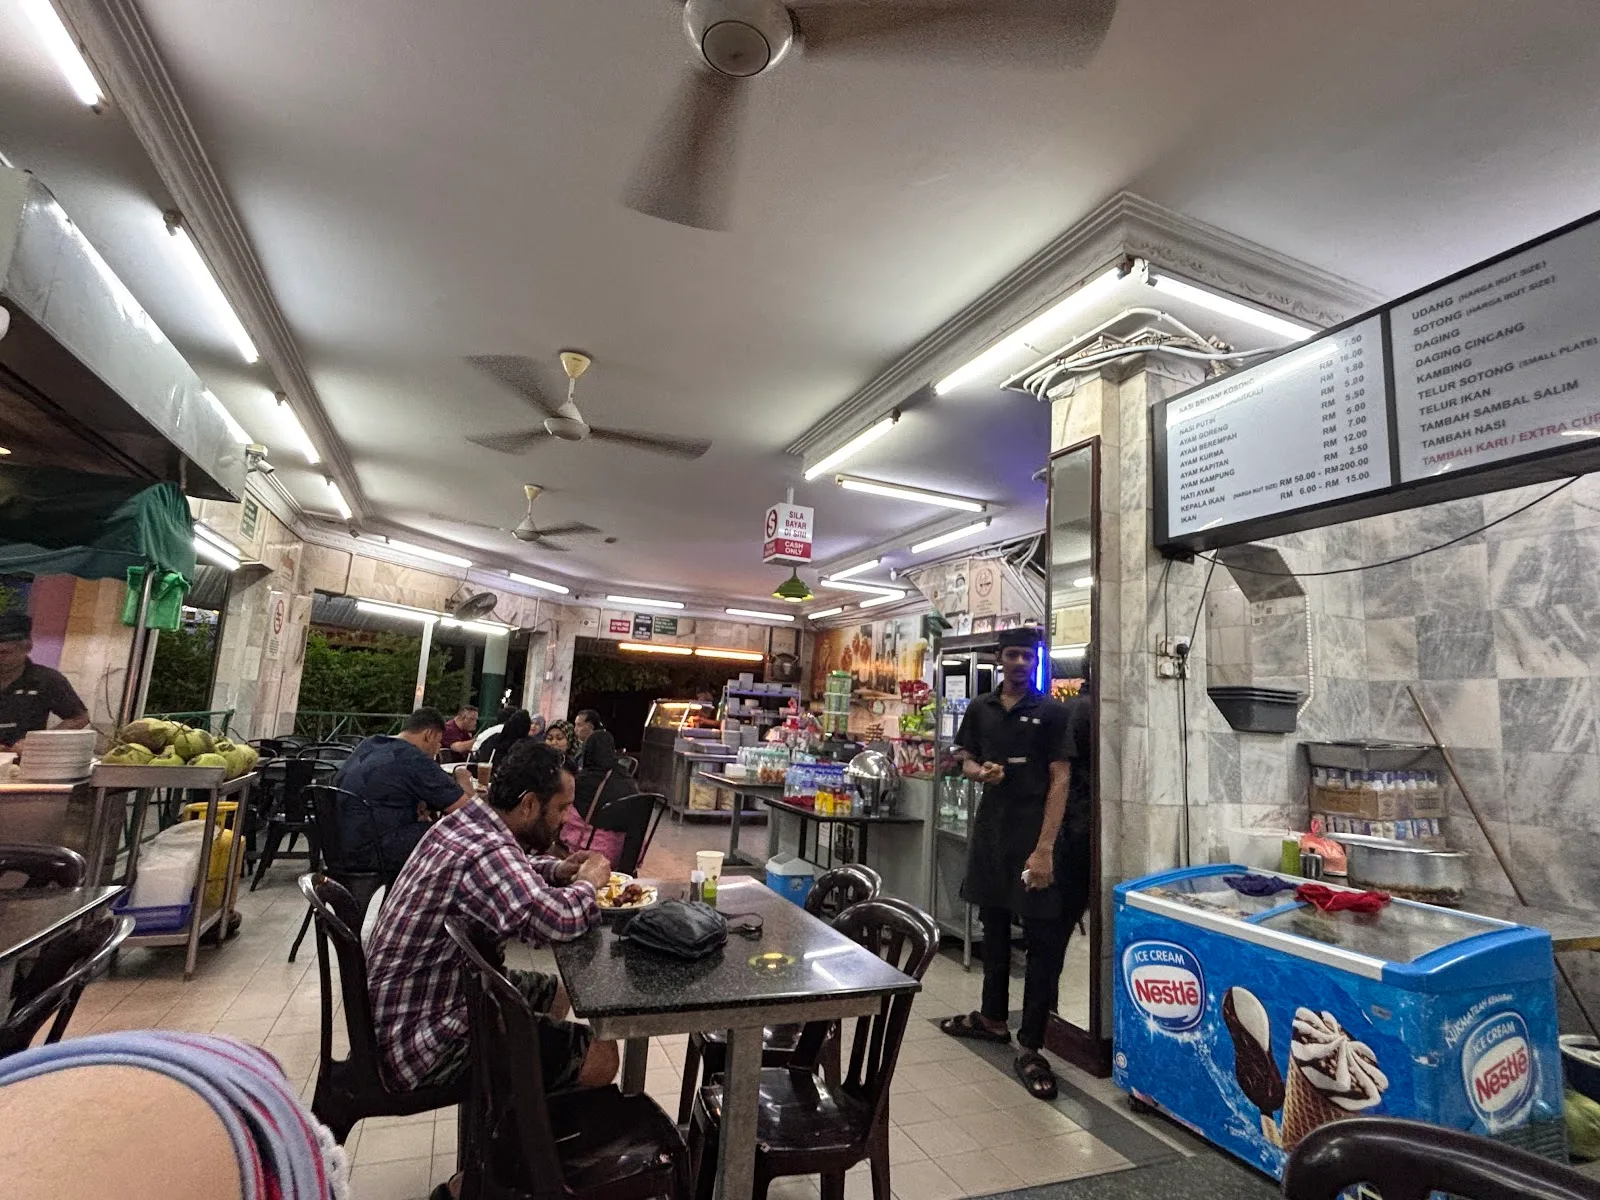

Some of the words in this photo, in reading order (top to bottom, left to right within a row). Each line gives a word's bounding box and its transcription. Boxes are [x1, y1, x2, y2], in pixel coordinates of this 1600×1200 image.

[1411, 297, 1453, 320] UDANG
[1458, 282, 1494, 302] (HARGA
[1495, 272, 1517, 286] IKUT
[1519, 260, 1547, 277] SIZE)
[1413, 310, 1462, 336] SOTONG
[1466, 298, 1502, 316] (HARGA
[1503, 287, 1526, 300] IKUT
[1528, 275, 1556, 291] SIZE)
[1414, 328, 1460, 352] DAGING
[1415, 345, 1461, 368] DAGING
[1464, 322, 1525, 350] CINCANG
[1319, 360, 1333, 370] RM
[1416, 358, 1472, 384] KAMBING
[1418, 381, 1456, 400] TELUR
[1459, 362, 1514, 387] SOTONG
[1519, 351, 1557, 368] (SMALL
[1179, 402, 1194, 413] NASI
[1195, 391, 1222, 407] BRIYANI
[1180, 425, 1195, 435] NASI
[1320, 372, 1334, 384] RM
[1345, 361, 1364, 374] 1.80
[1180, 435, 1197, 446] AYAM
[1199, 424, 1229, 440] GORENG
[1320, 385, 1335, 396] RM
[1344, 375, 1364, 388] 5.00
[1419, 398, 1458, 416] TELUR
[1461, 388, 1491, 404] IKAN
[1420, 412, 1470, 432] TAMBAH
[1473, 395, 1531, 418] SAMBAL
[1533, 380, 1579, 400] SALIM
[1180, 446, 1197, 457] AYAM
[1199, 432, 1237, 450] BEREMPAH
[1321, 399, 1336, 409] RM
[1345, 388, 1365, 401] 5.50
[1180, 457, 1198, 468] AYAM
[1200, 449, 1224, 462] KURMA
[1322, 411, 1336, 422] RM
[1346, 402, 1366, 415] 5.00
[1421, 429, 1472, 449] TAMBAH
[1475, 419, 1507, 435] NASI
[1423, 447, 1473, 466] TAMBAH
[1476, 436, 1509, 453] KARI
[1519, 422, 1567, 442] EXTRA
[1180, 468, 1198, 479] AYAM
[1200, 458, 1229, 473] KAPITAN
[1322, 425, 1337, 436] RM
[1348, 415, 1367, 428] 7.00
[1180, 480, 1198, 490] AYAM
[1200, 468, 1235, 485] KAMPUNG
[1323, 438, 1337, 449] RM
[1343, 429, 1368, 443] 12.00
[1181, 491, 1195, 501] HATI
[1196, 486, 1215, 498] AYAM
[1324, 452, 1338, 462] RM
[1349, 443, 1368, 455] 2.50
[1181, 500, 1207, 513] KEPALA
[1208, 495, 1225, 506] IKAN
[1280, 477, 1292, 487] RM
[1294, 471, 1316, 483] 50.00
[789, 511, 804, 520] SILA
[1181, 514, 1197, 524] IKAN
[1280, 490, 1293, 500] RM
[1299, 484, 1317, 495] 6.00
[1325, 478, 1339, 489] RM
[1345, 471, 1370, 483] 15.00
[784, 541, 804, 550] CASH
[785, 519, 807, 530] BAYAR
[784, 547, 803, 555] ONLY
[1134, 950, 1149, 964] ICE
[1150, 949, 1185, 965] CREAM
[1135, 979, 1199, 1006] Nestlé
[1472, 1035, 1486, 1055] ICE
[1486, 1020, 1516, 1043] CREAM
[1475, 1045, 1527, 1104] Nestlé
